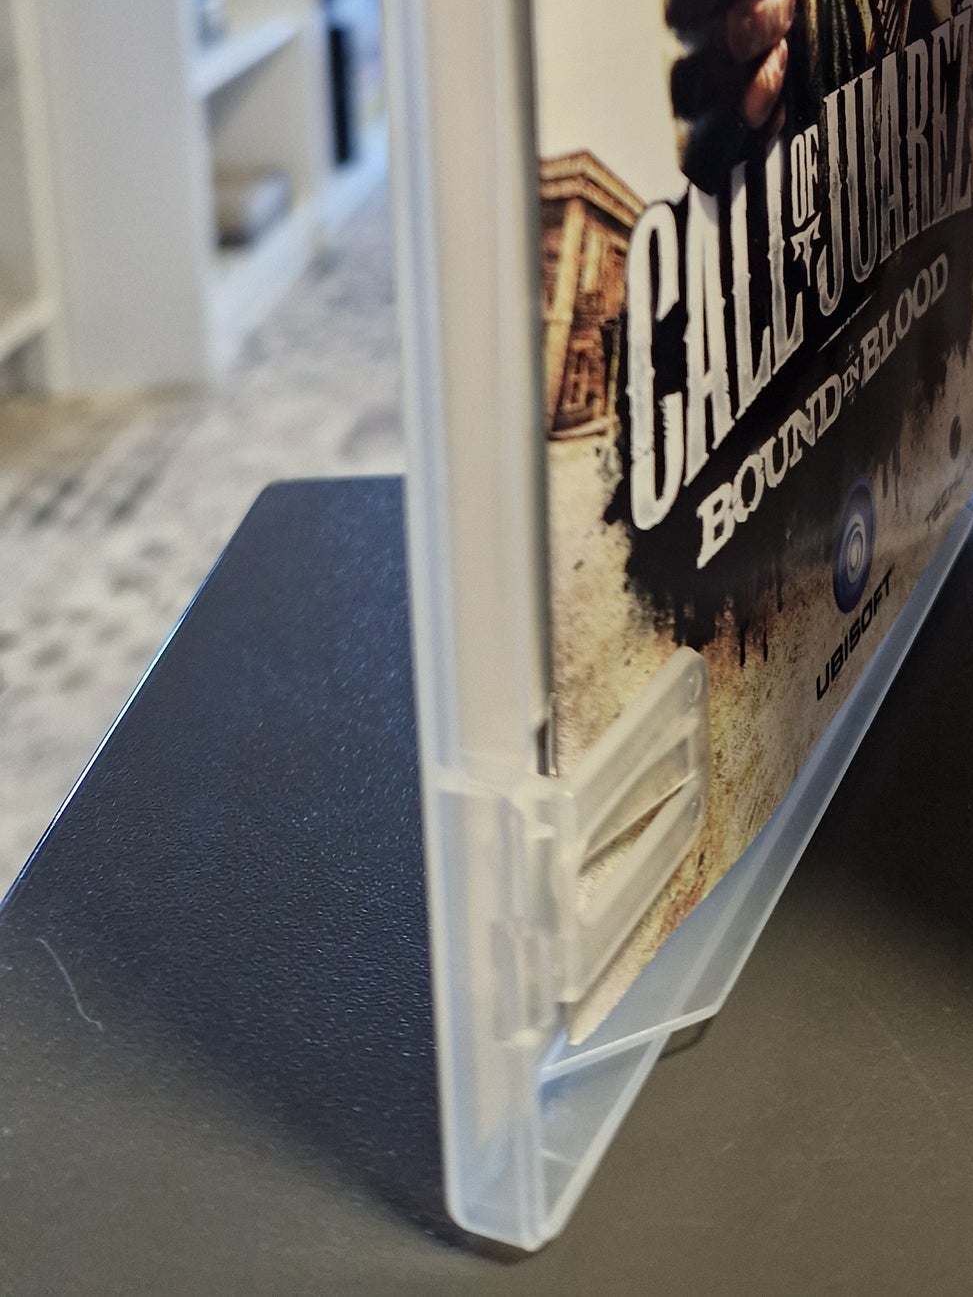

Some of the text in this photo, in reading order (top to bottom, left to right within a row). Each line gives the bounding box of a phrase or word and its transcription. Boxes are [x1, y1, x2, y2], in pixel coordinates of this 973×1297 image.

[625, 136, 803, 531] CALL
[790, 124, 820, 228] OF
[816, 6, 973, 316] JUAREZ
[697, 253, 949, 569] BOUND IN BLOOD
[816, 567, 894, 701] UBISOFT
